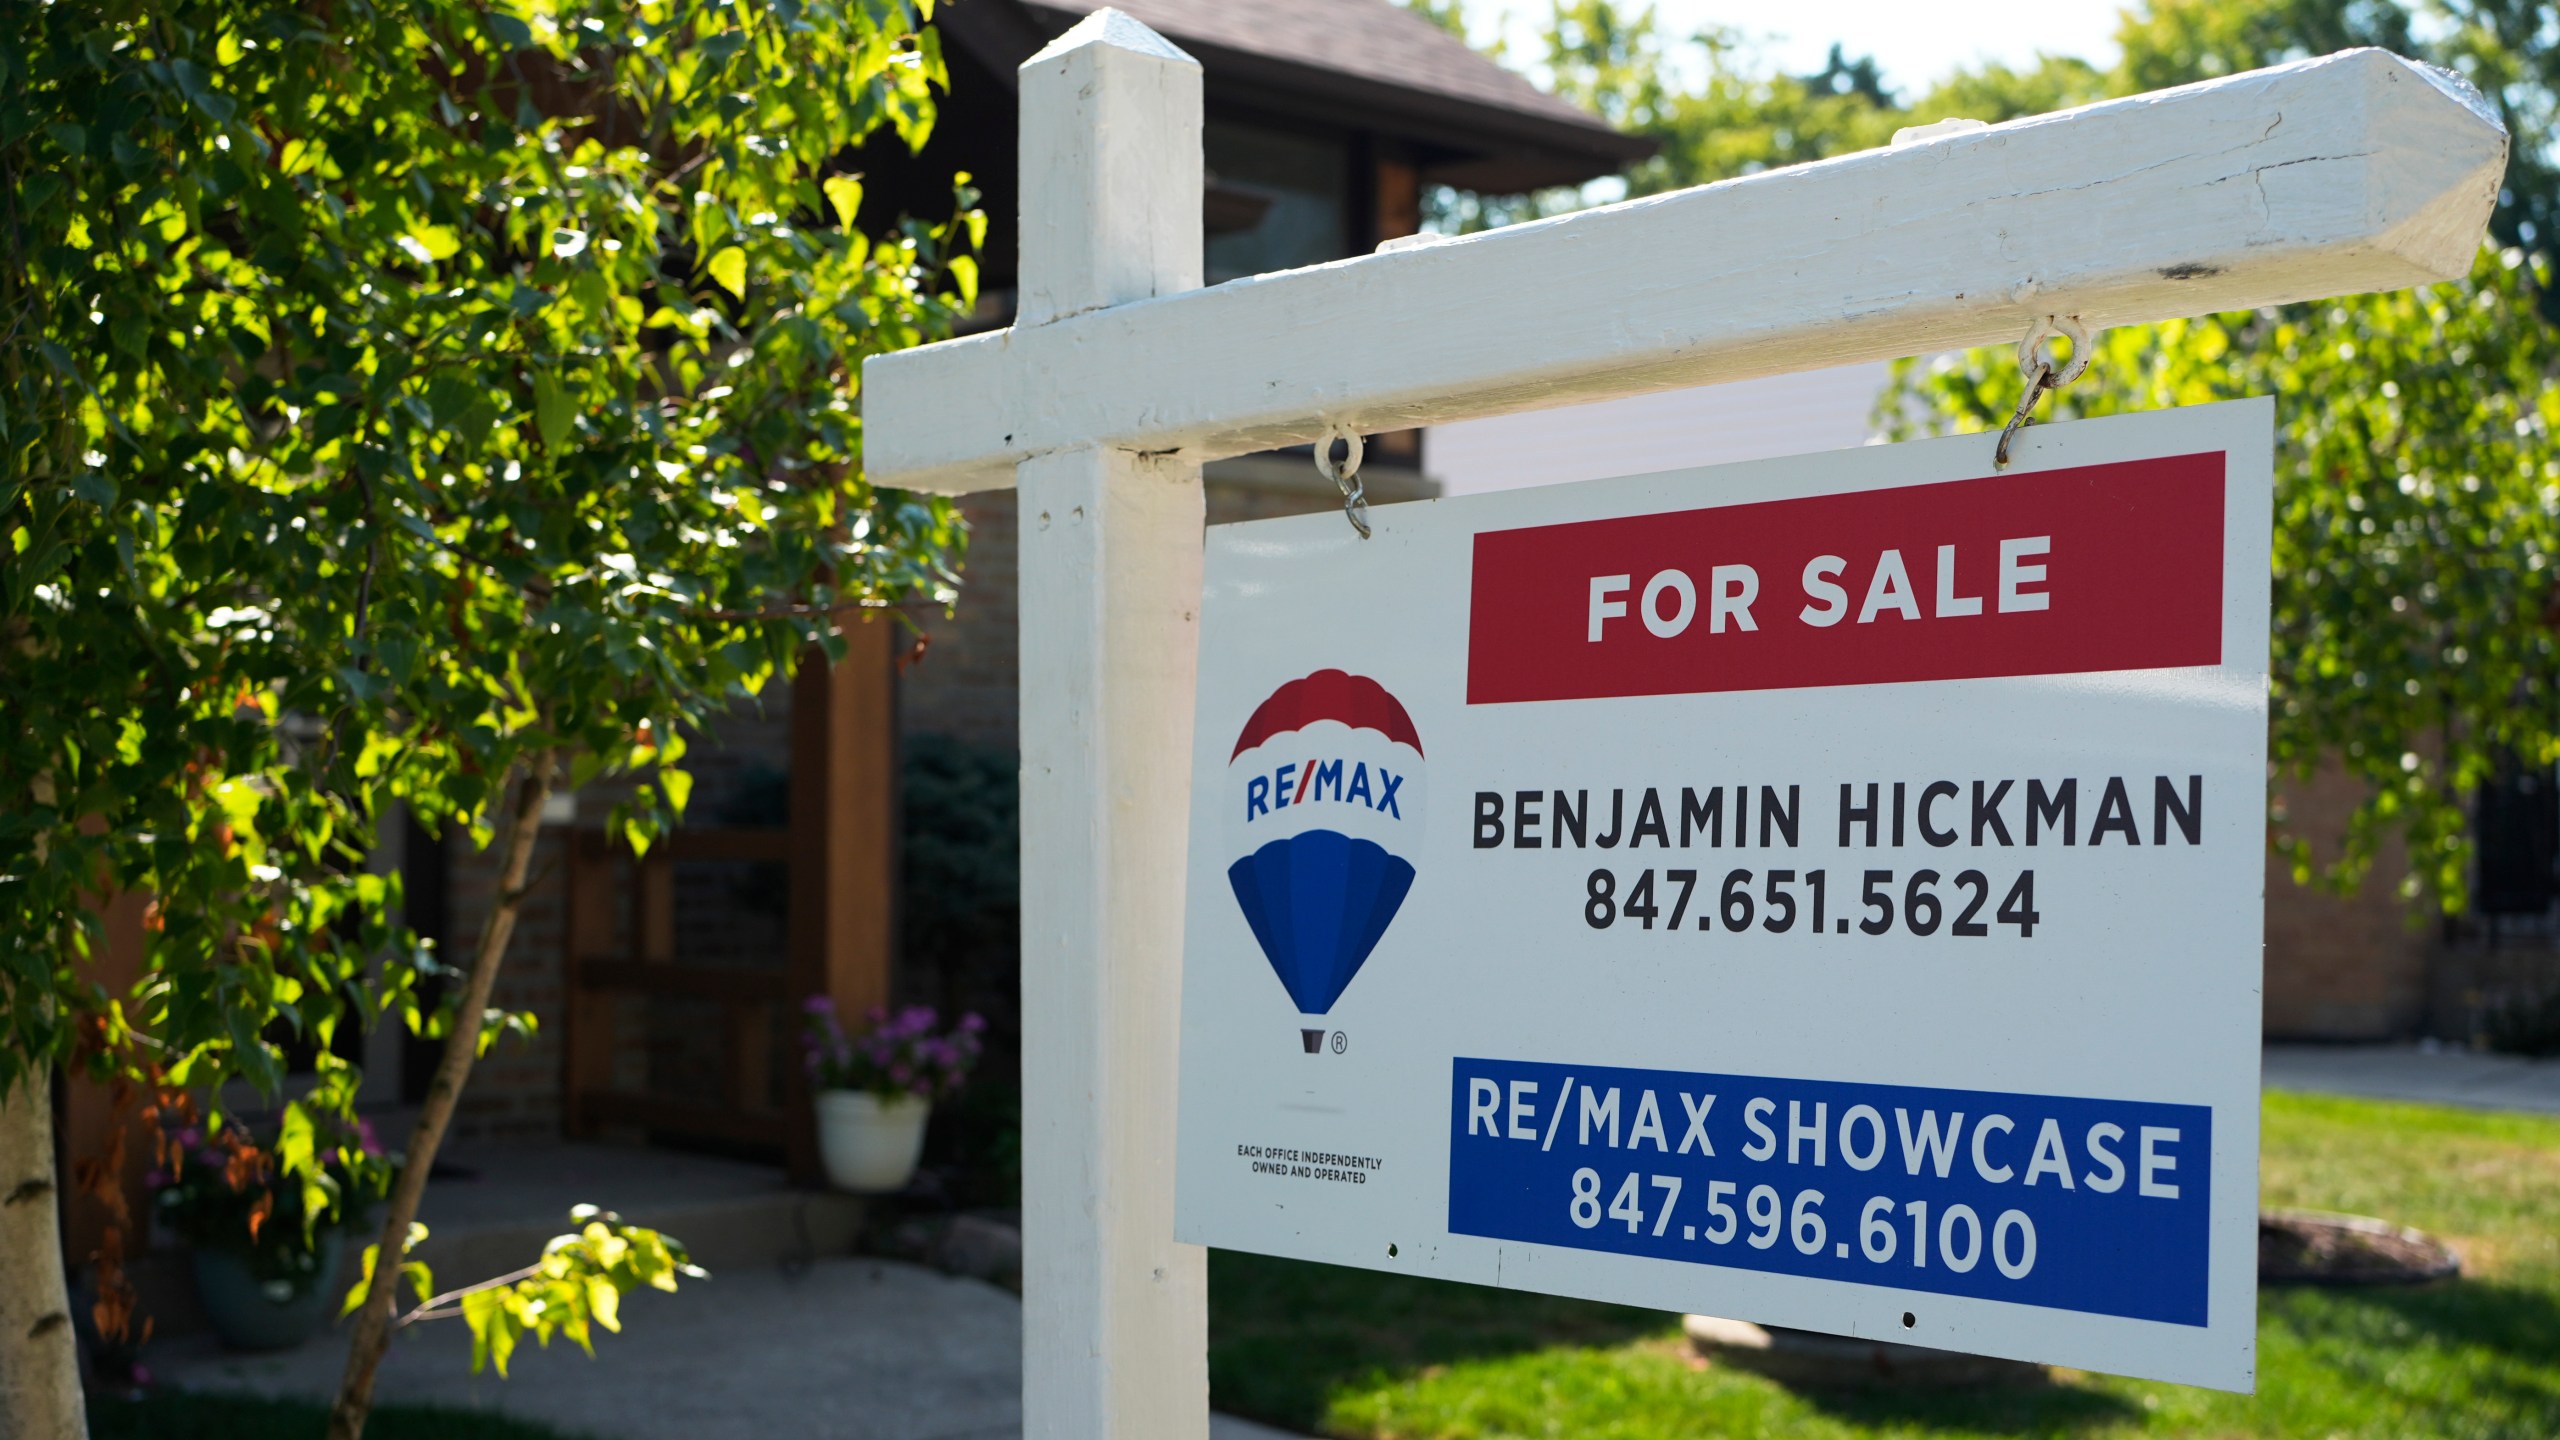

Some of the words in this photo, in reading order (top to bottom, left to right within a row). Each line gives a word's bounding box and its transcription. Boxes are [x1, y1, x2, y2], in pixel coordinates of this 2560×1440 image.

[1587, 563, 1760, 643] FOR
[1798, 535, 2052, 628] SALE
[1246, 758, 1404, 823] RE/MAX
[1473, 784, 1800, 850] BENJAMIN
[1838, 774, 2203, 849] HICKMAN
[1584, 868, 2040, 939] 847.651.5624
[1237, 1144, 1262, 1157] EACH
[1265, 1147, 1299, 1162] OFFICE
[1301, 1151, 1383, 1170] INDEPENDENTLY
[1251, 1161, 1288, 1175] OWNED
[1290, 1166, 1311, 1179] AND
[1314, 1167, 1366, 1184] OPERATED
[1467, 1076, 1717, 1158] RE/MAX
[1740, 1096, 2181, 1201] SHOWCASE
[1569, 1166, 2038, 1281] 847.596.6100
